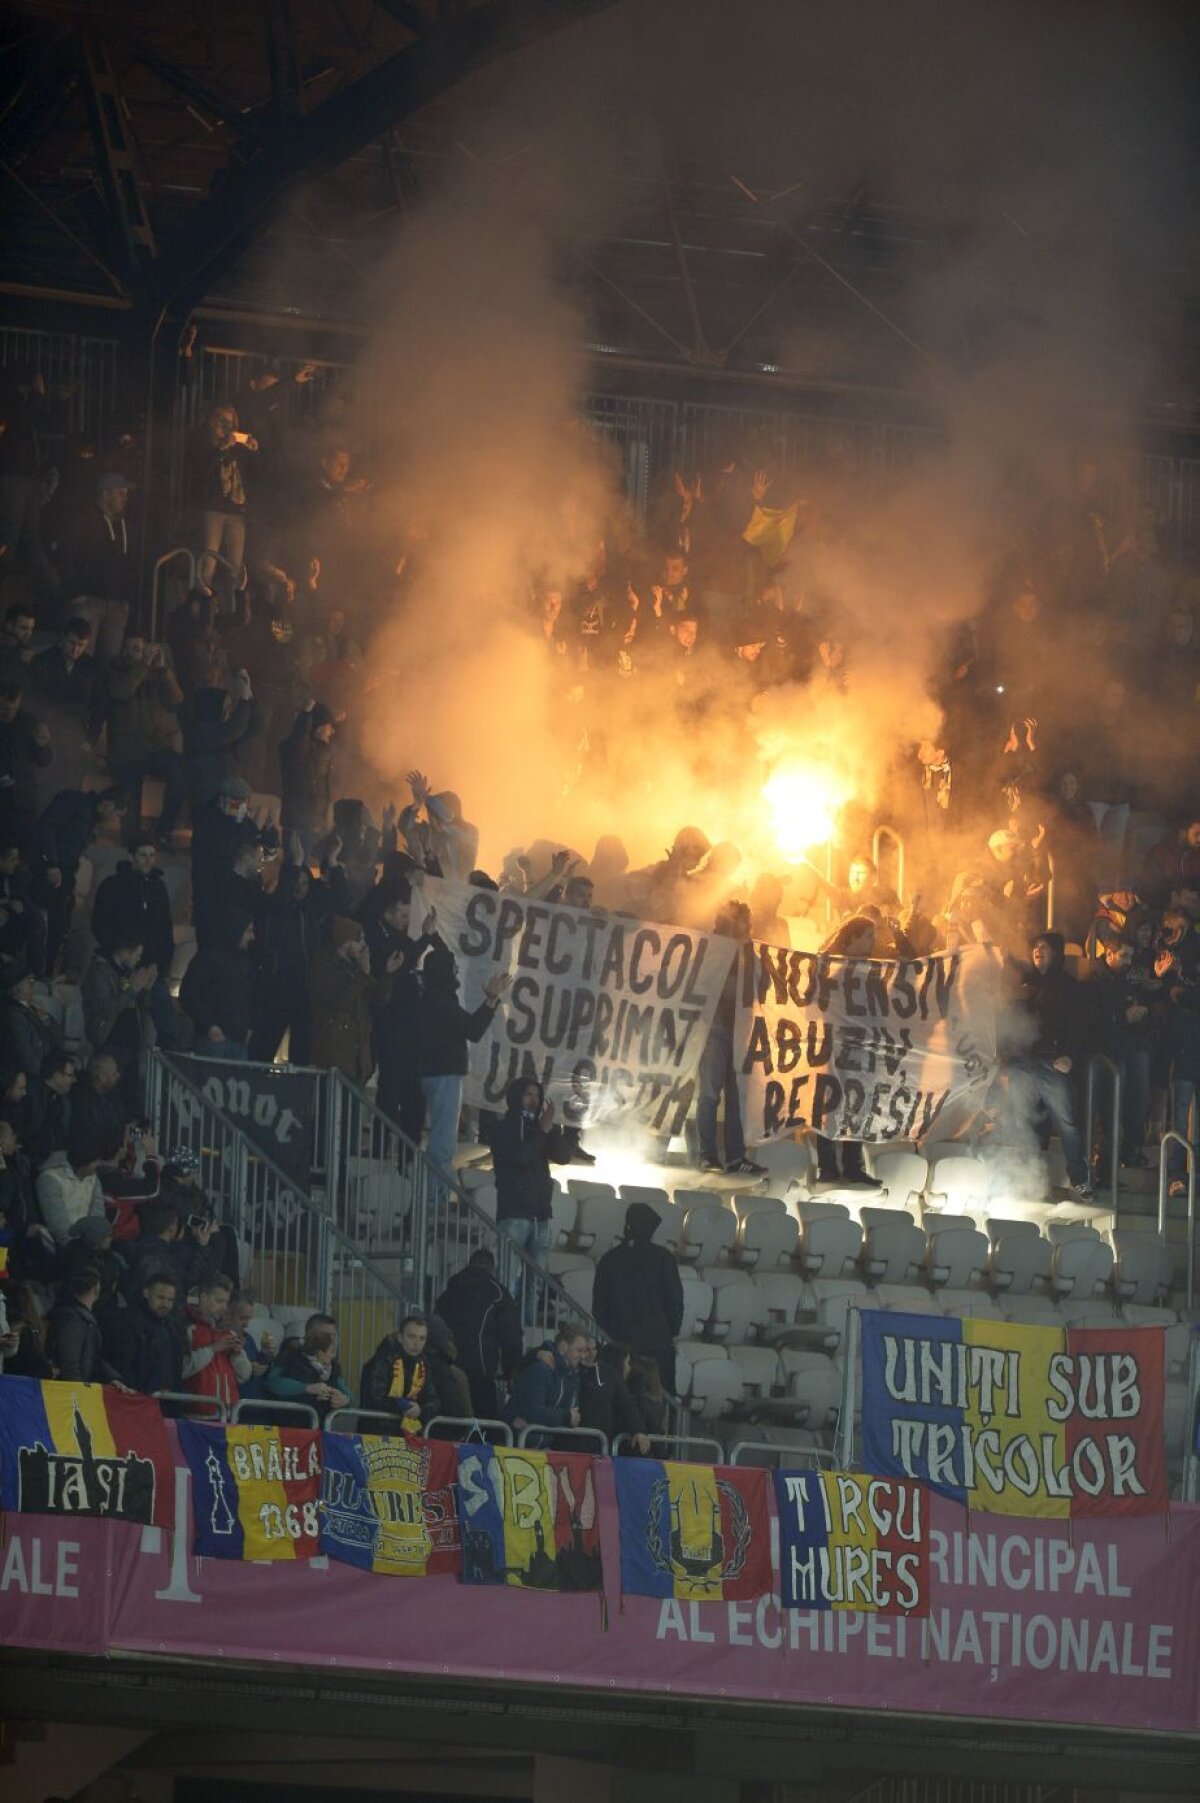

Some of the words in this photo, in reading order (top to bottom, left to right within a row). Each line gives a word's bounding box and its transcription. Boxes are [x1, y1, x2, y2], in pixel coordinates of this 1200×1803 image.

[459, 893, 709, 1005] SPECTACOL
[743, 941, 959, 1020] INOFENSIV
[507, 977, 702, 1066] SUPRIMAT
[764, 1074, 950, 1139] REPRESIV
[1046, 1352, 1141, 1420] SUB
[234, 1439, 321, 1481] BRĂILA
[891, 1418, 1148, 1497] TRICOLOR
[259, 1502, 319, 1539] 1368
[0, 1535, 81, 1599] ALE
[790, 1545, 920, 1616] MUREȘ
[930, 1529, 1132, 1598] RINCIPAL
[656, 1597, 716, 1644] AL
[728, 1594, 906, 1658] ECHIPEI
[921, 1609, 1174, 1682] NAȚIONALE
